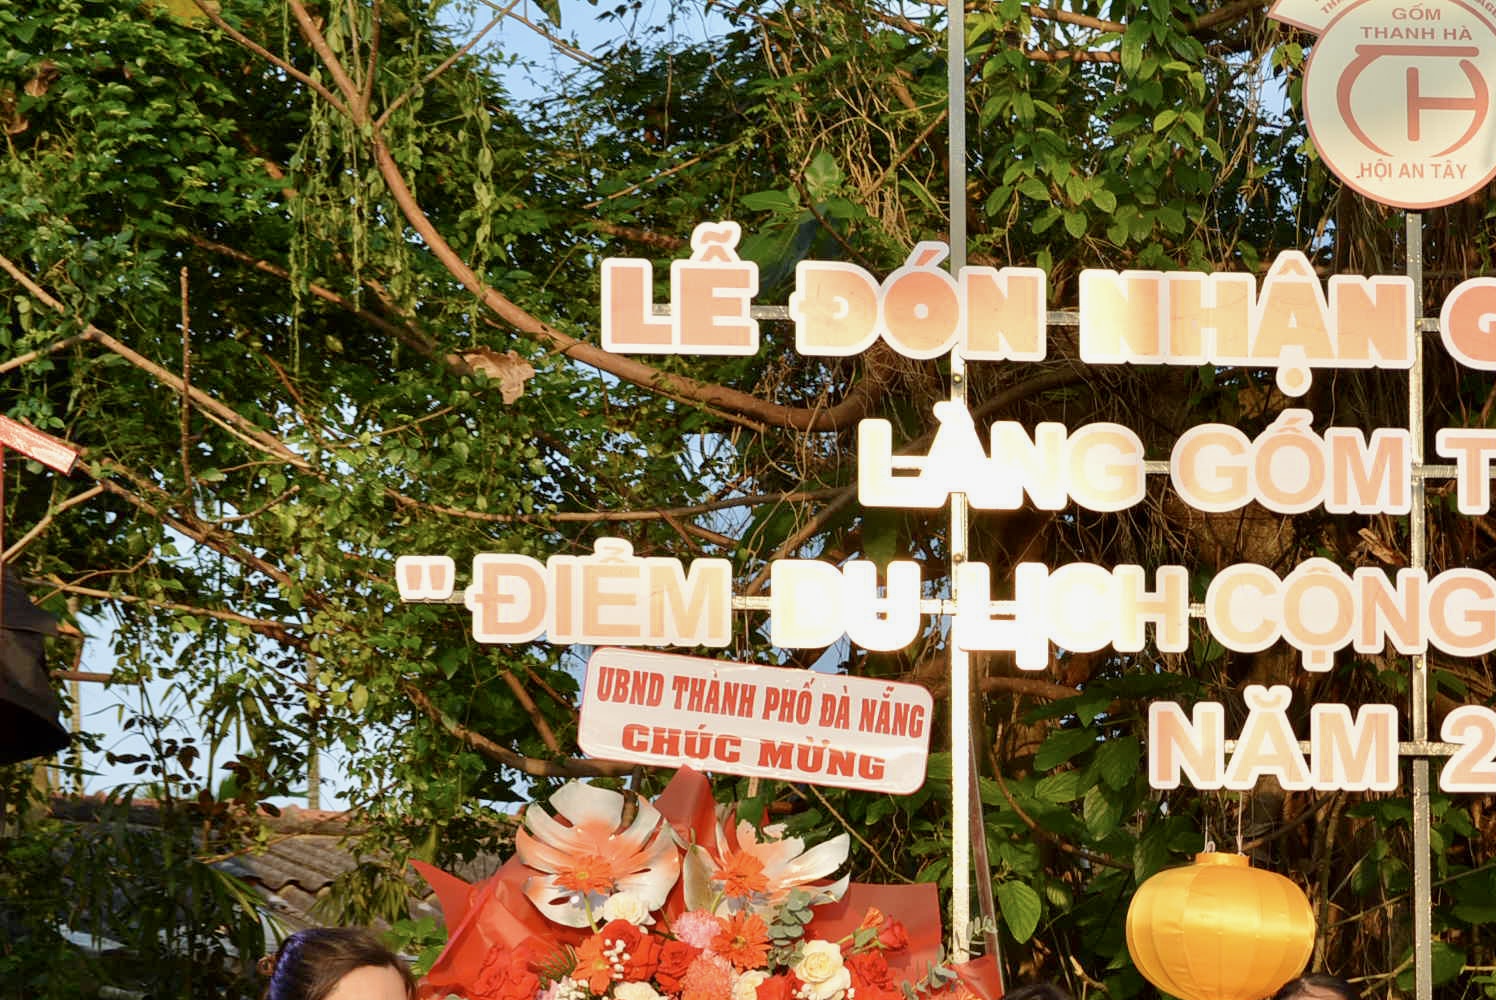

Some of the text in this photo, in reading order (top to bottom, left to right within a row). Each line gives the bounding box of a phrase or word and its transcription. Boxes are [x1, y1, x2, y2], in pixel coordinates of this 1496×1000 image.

[1360, 25, 1473, 41] THANH HÀ
[1392, 4, 1441, 21] GỐM
[1359, 158, 1467, 180] HỘI AN TÂY
[601, 221, 758, 354] LỄ
[789, 241, 1046, 361] ĐÓN
[1079, 250, 1415, 397] NHẬN
[858, 401, 1145, 512] LÀNG
[1170, 408, 1411, 514] GỐM
[771, 558, 920, 652] DU
[958, 561, 1189, 671] LỊCH
[597, 666, 926, 738] UBND THÀNH PHỐ ĐÀ NẴNG
[1148, 685, 1399, 791] NĂM
[622, 724, 886, 780] CHÚC MỪNG
